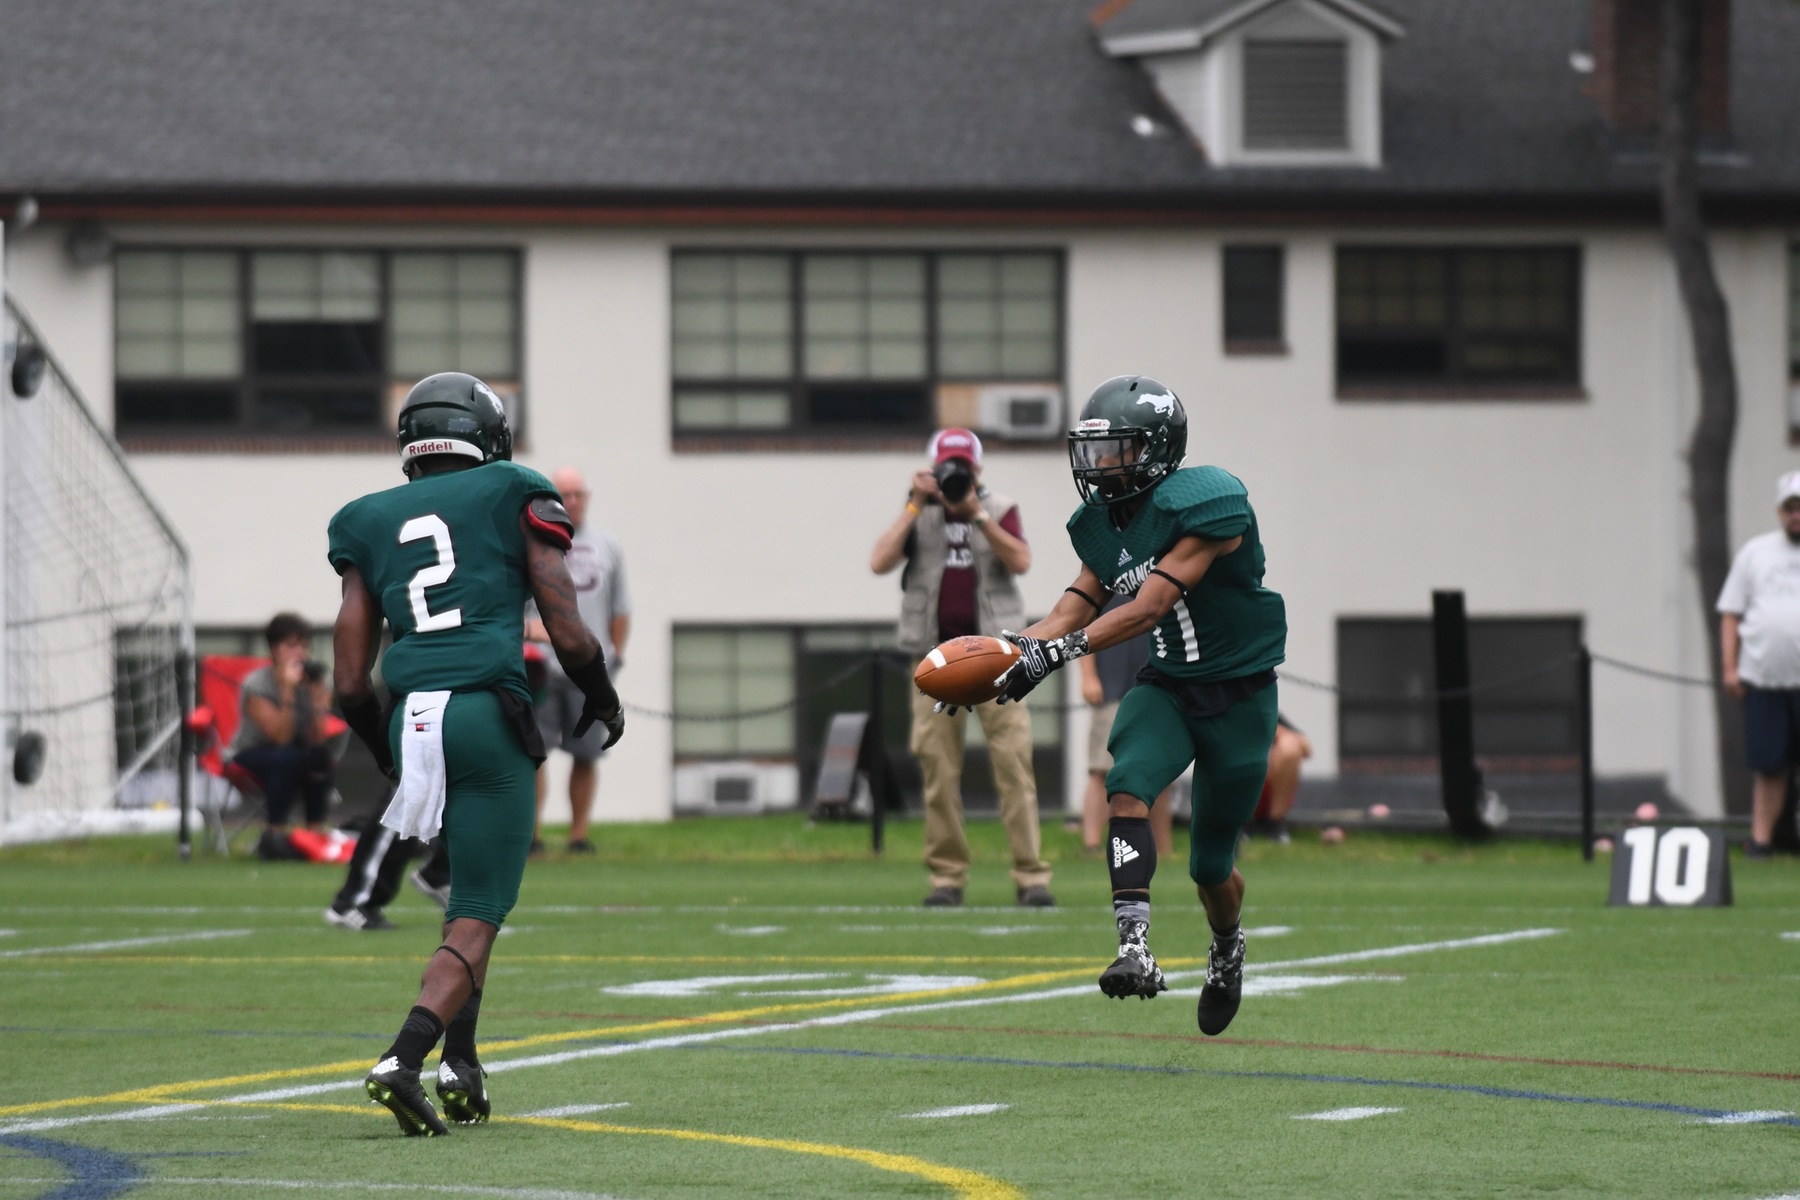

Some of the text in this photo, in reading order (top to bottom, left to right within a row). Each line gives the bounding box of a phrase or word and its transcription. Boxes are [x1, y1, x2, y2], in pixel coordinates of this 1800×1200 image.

[409, 442, 453, 455] Riddell
[399, 514, 462, 633] 2
[1112, 836, 1124, 868] adidas
[1623, 826, 1710, 904] 10
